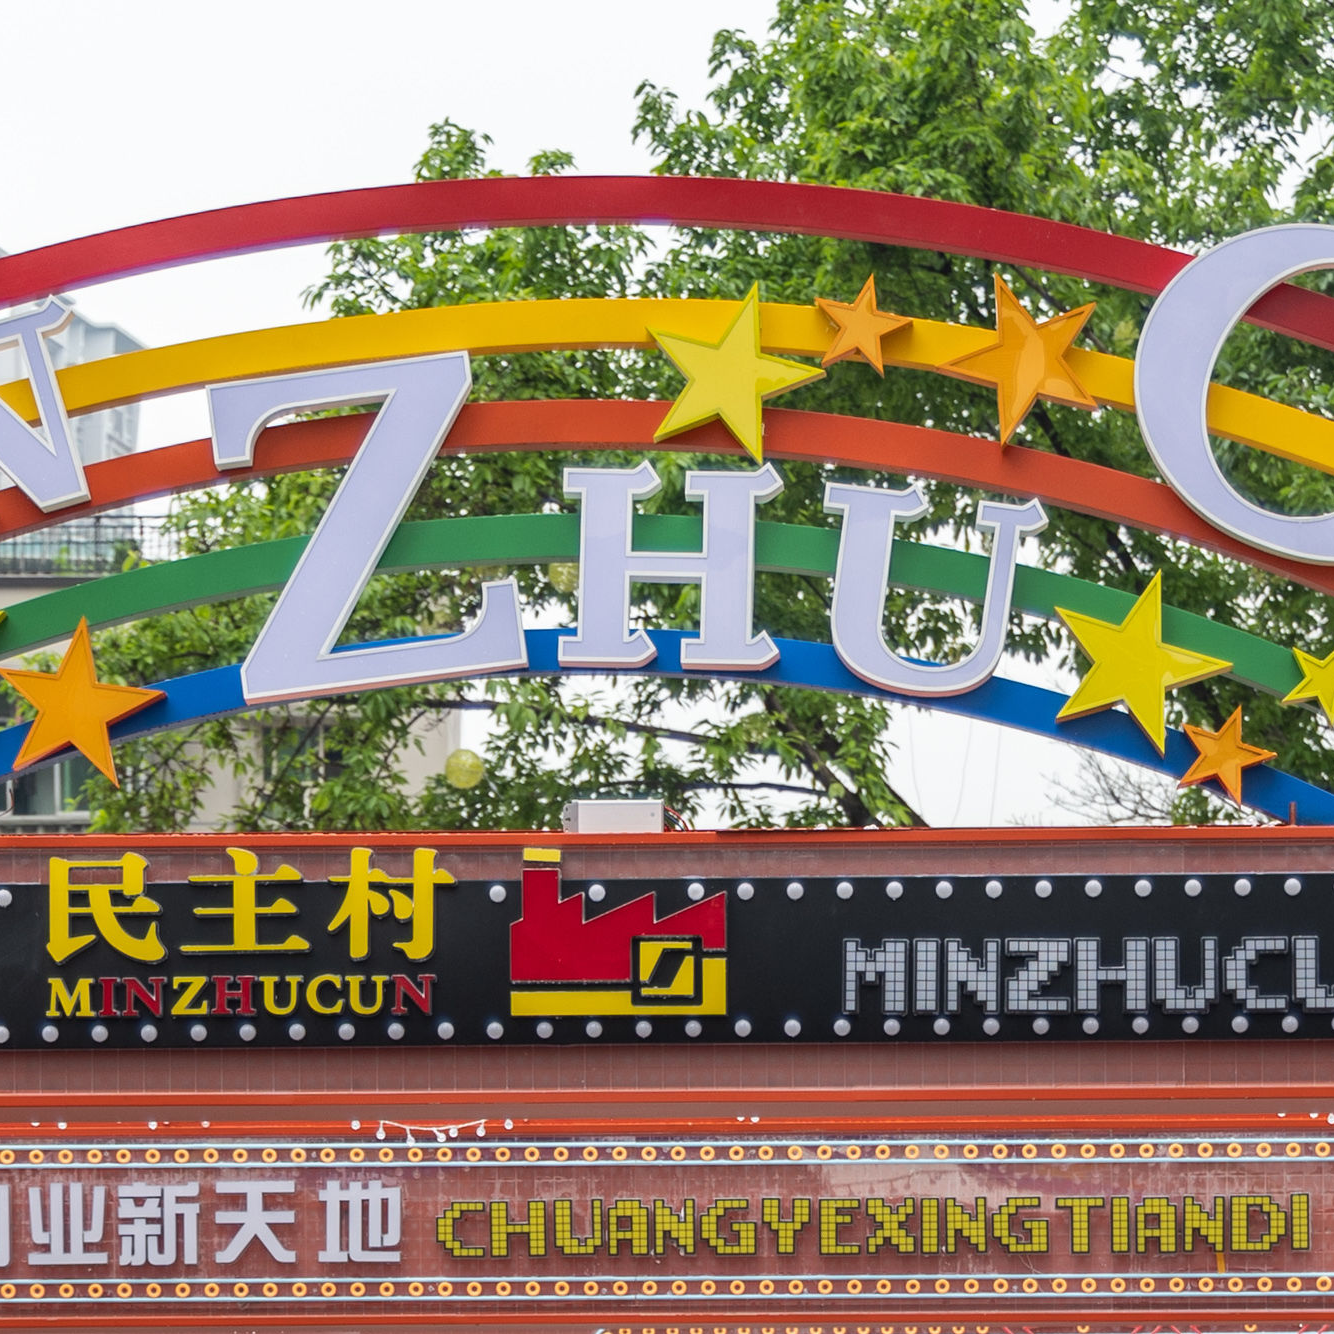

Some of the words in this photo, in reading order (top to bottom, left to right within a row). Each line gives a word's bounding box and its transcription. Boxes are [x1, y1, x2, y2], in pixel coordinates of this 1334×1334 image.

[205, 351, 1049, 706] ZHU
[44, 846, 457, 965] 民主村
[44, 973, 437, 1020] MINZHUCUN
[435, 1192, 1312, 1260] CHUANGYEXINGTIANDI
